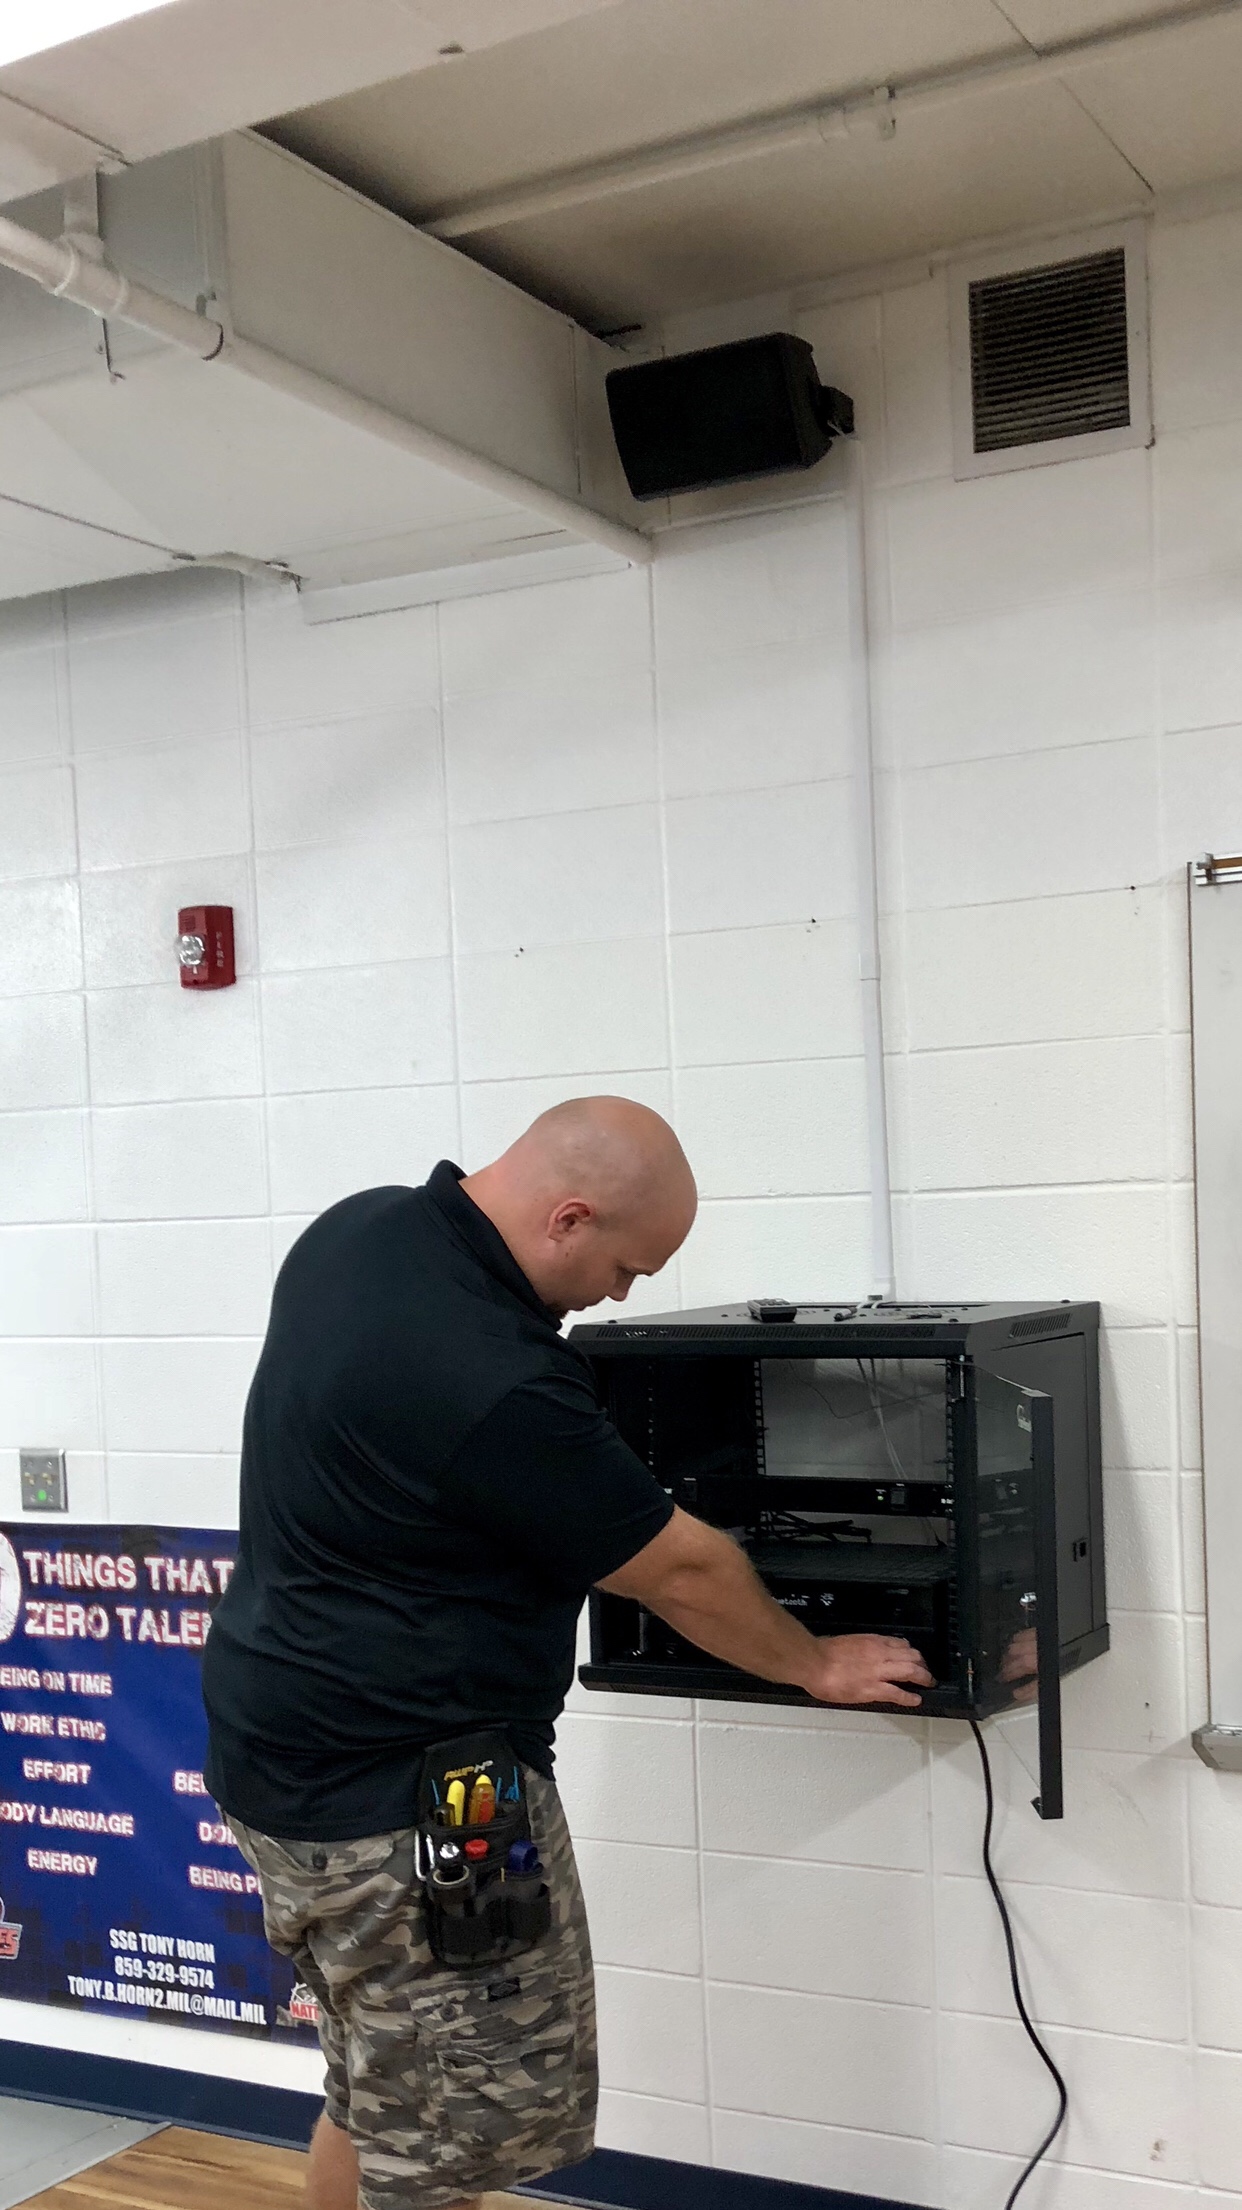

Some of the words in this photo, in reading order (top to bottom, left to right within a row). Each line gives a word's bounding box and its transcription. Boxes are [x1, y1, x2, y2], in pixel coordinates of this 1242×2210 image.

[22, 1551, 137, 1590] THINGS
[143, 1556, 235, 1594] THAT
[24, 1601, 110, 1638] ZERO
[42, 1670, 66, 1693] ON
[67, 1672, 113, 1696] TIME
[0, 1711, 55, 1736] WORK
[57, 1715, 107, 1741] ETHIC
[22, 1758, 91, 1785] EFFORT
[39, 1805, 135, 1836] LANGUAGE
[27, 1848, 98, 1876] ENERGY
[188, 1865, 243, 1892] BEING
[109, 1928, 138, 1952] SSG
[139, 1932, 175, 1958] TONY
[176, 1937, 216, 1964] HORN
[114, 1955, 215, 1990] 859-329-9574
[67, 1974, 267, 2025] TONY.B.HORN2.MIL@MAIL.MIL
